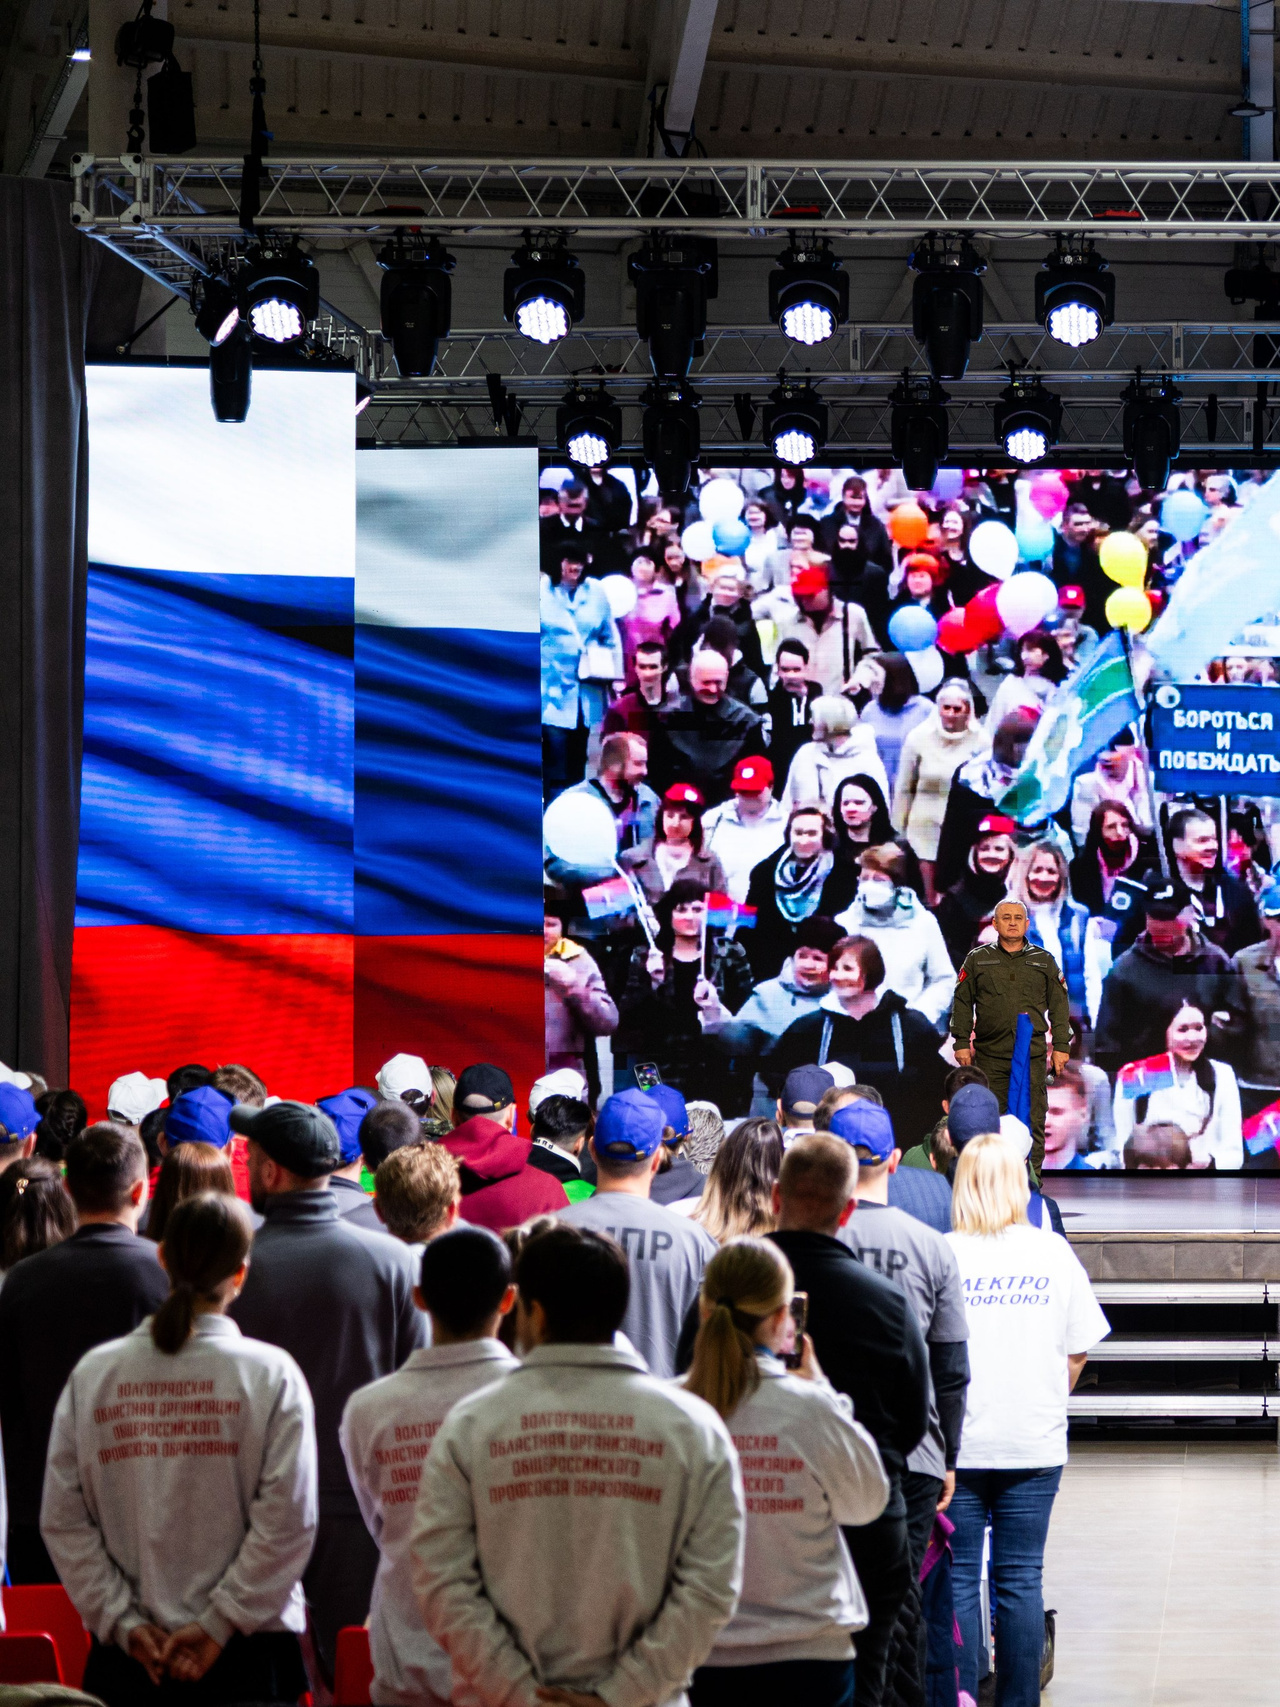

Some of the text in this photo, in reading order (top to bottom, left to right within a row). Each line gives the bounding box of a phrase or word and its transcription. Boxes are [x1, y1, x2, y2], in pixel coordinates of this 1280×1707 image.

[1173, 709, 1274, 731] БОРОТЬСЯ
[1216, 732, 1231, 750] И
[117, 1379, 214, 1399] ВОЛГОГРАДСКАЯ
[93, 1400, 241, 1424] ОБЛАСТНАЯ ОРГАНИЗАЦИЯ
[520, 1411, 634, 1431] ВОЛГОГРАДСКАЯ
[112, 1420, 221, 1441] ОБЩЕРОССИЙСКОГО
[161, 1440, 239, 1458] ОБРАЗОВАНИЯ
[489, 1432, 664, 1460] ОБЛАСТНАЯ ОРГАНИЗАЦИЯ
[512, 1455, 641, 1478] ОБЩЕРОССИЙСКОГО
[489, 1478, 663, 1505] ПРОФСОЮЗА ОБРАЗОВАНИЯ
